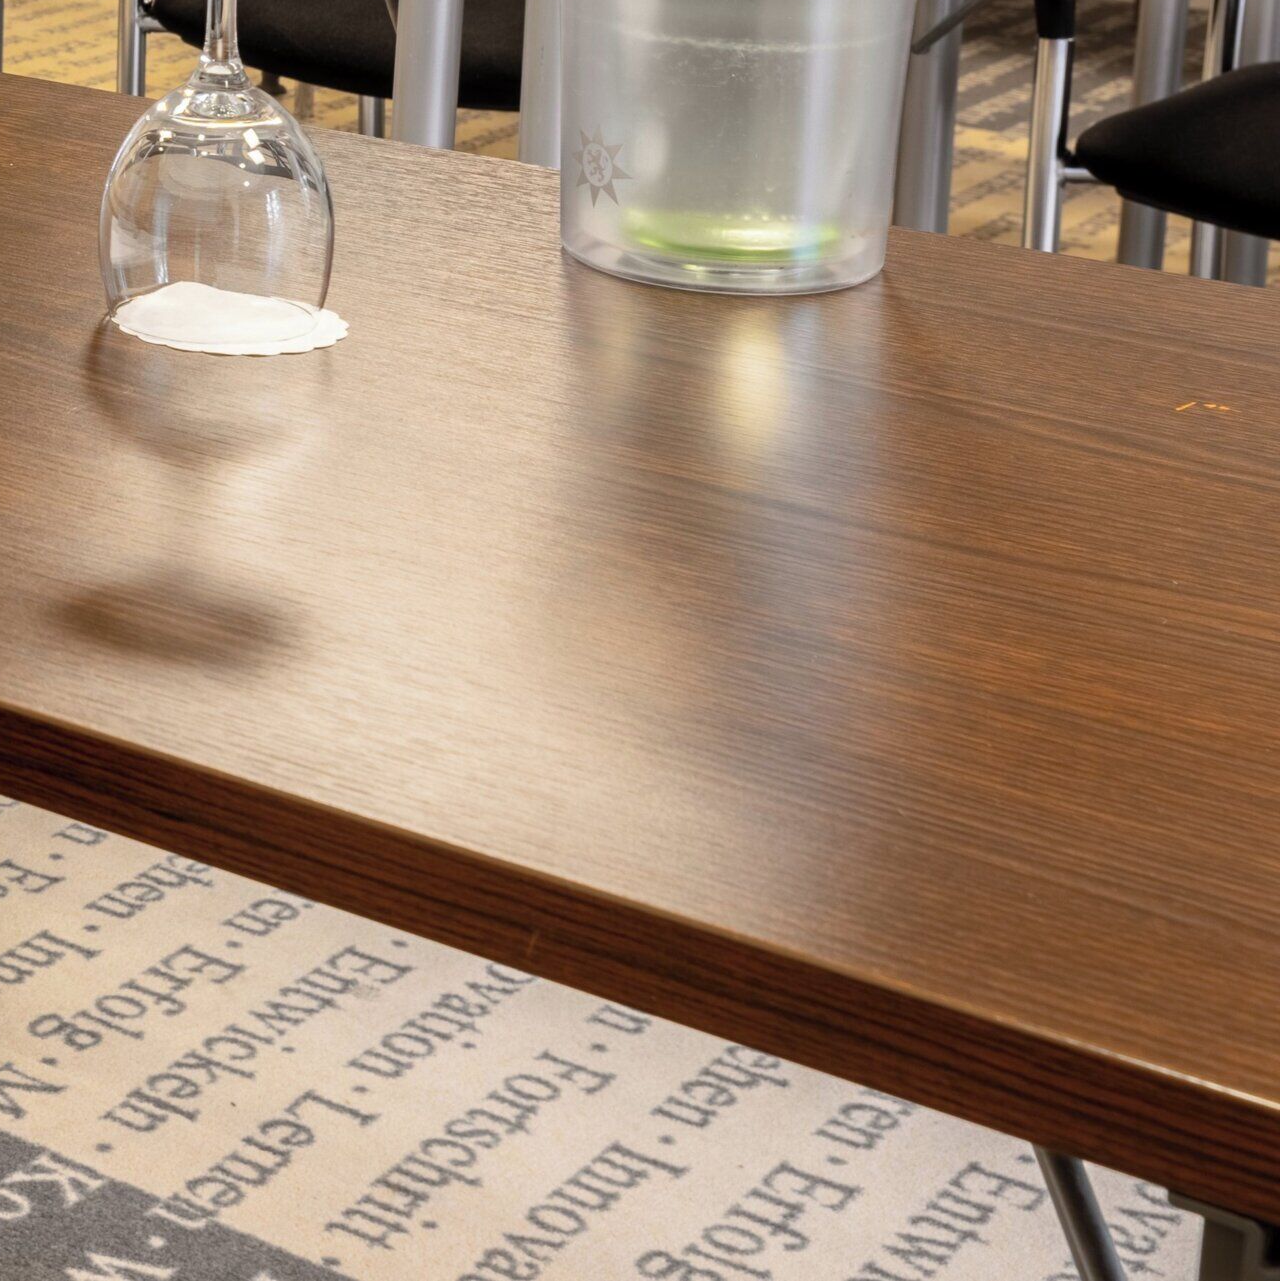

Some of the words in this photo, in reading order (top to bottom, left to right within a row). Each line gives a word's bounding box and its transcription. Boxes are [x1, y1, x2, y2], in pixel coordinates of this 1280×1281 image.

[17, 944, 253, 1053] Erfolg
[81, 943, 427, 1135] Entwickeln
[126, 1086, 383, 1229] Lernen
[307, 1049, 629, 1257] Fortschritt
[444, 1138, 694, 1281] Innova
